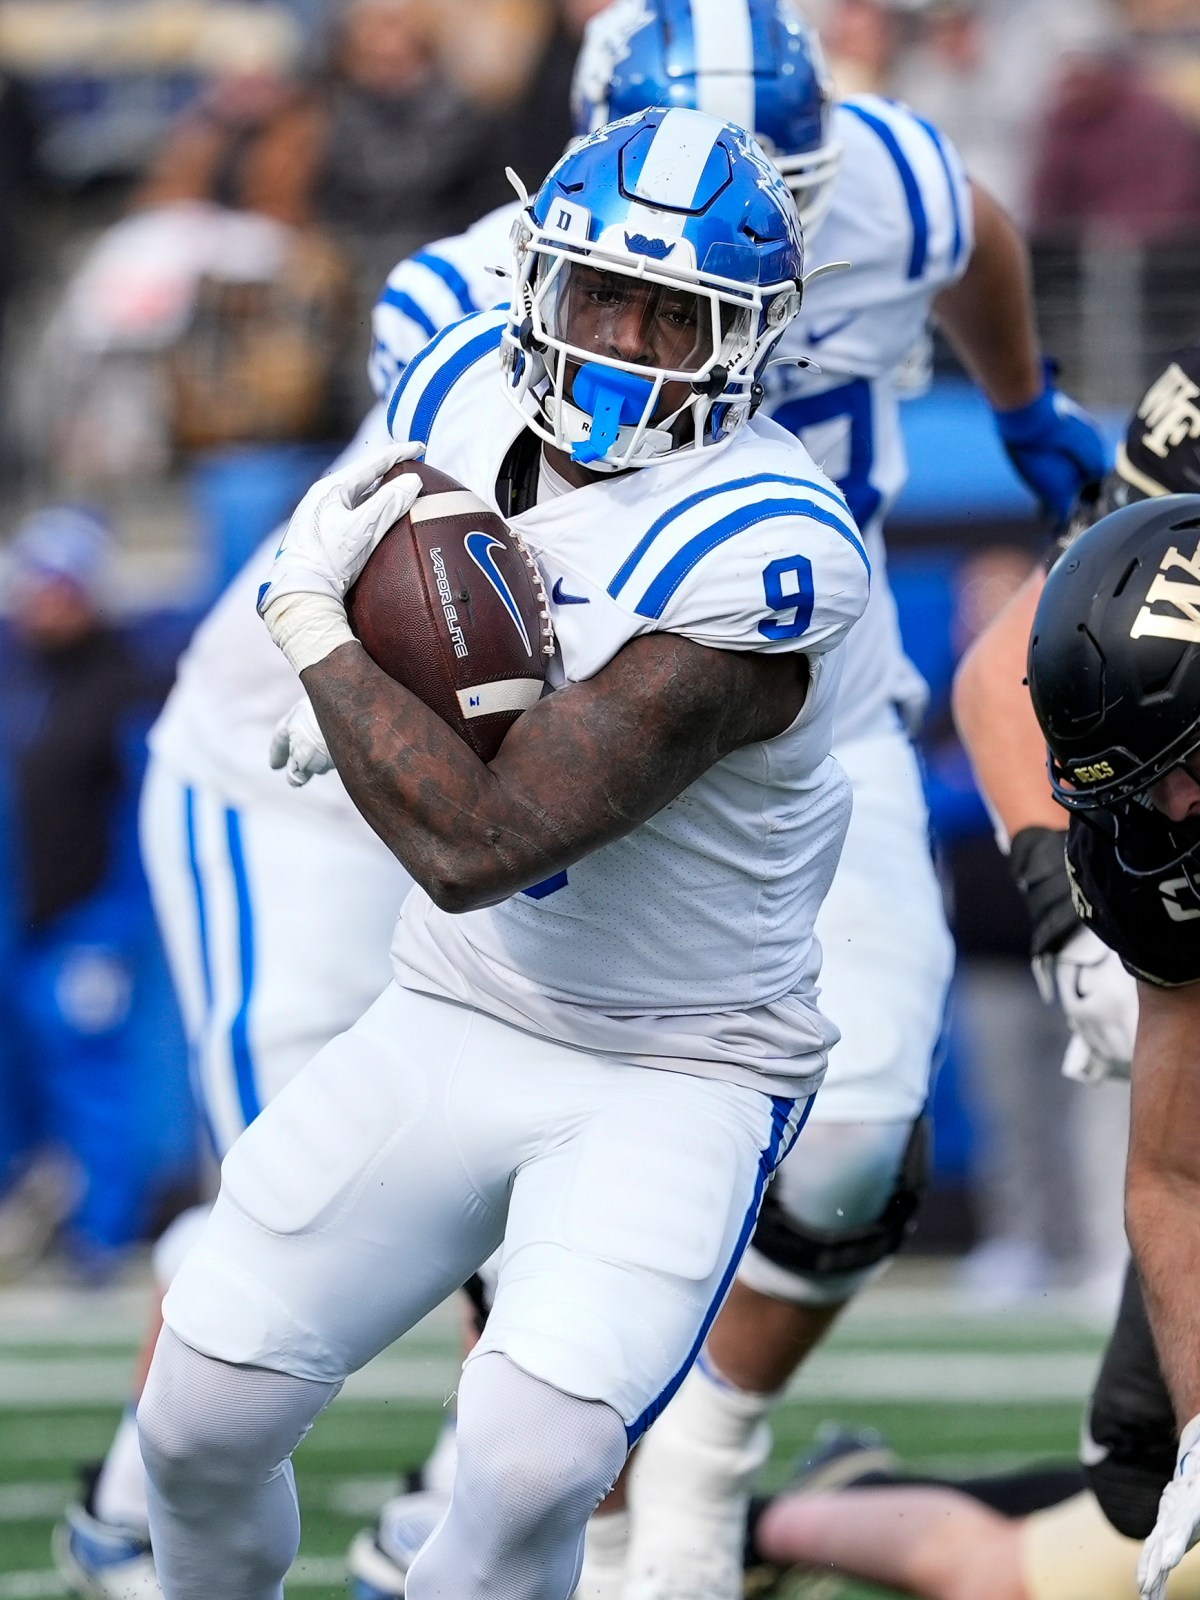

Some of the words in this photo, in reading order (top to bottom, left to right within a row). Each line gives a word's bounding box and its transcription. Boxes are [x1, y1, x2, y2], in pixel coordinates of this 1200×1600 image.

[429, 547, 452, 606] VAPOR
[443, 604, 469, 659] ELITE
[758, 554, 814, 641] 9
